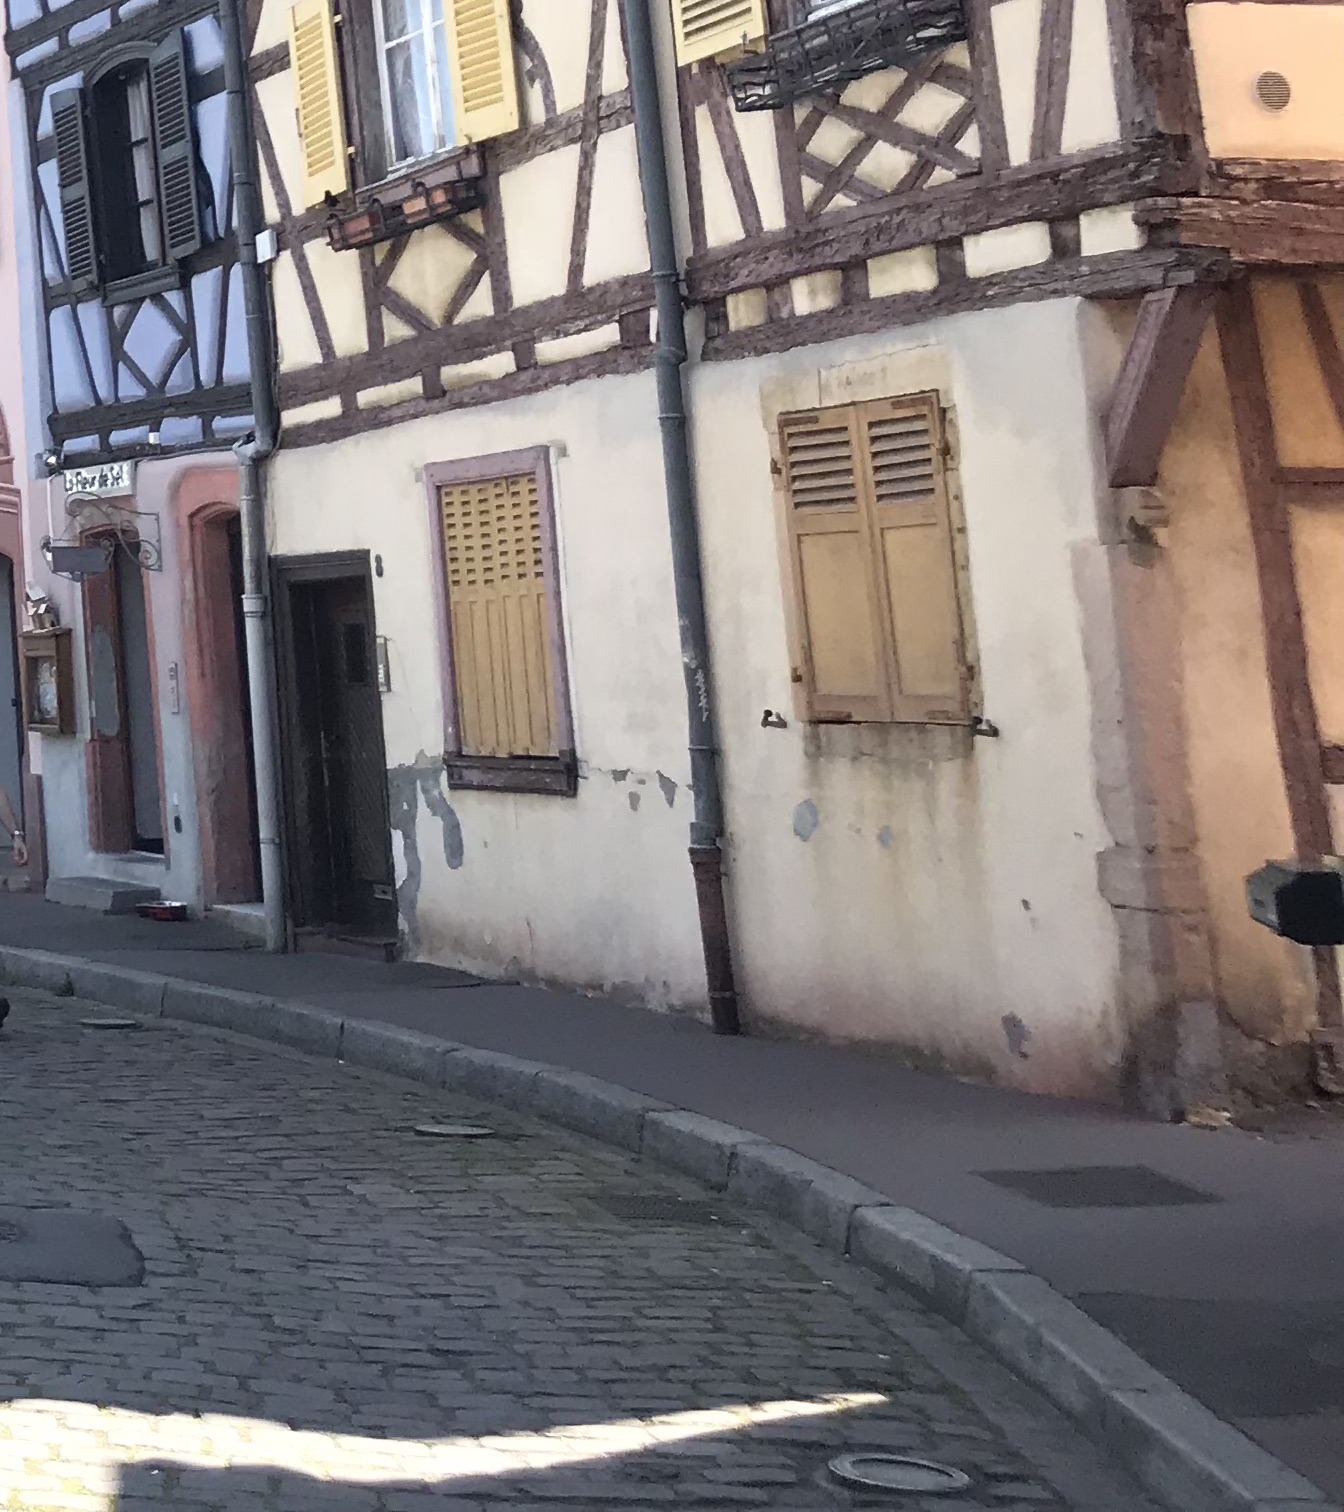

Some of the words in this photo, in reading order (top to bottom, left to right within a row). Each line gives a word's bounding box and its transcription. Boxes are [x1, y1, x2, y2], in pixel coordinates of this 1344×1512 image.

[75, 472, 97, 490] Fleur
[98, 468, 109, 488] de
[110, 464, 124, 487] Sel
